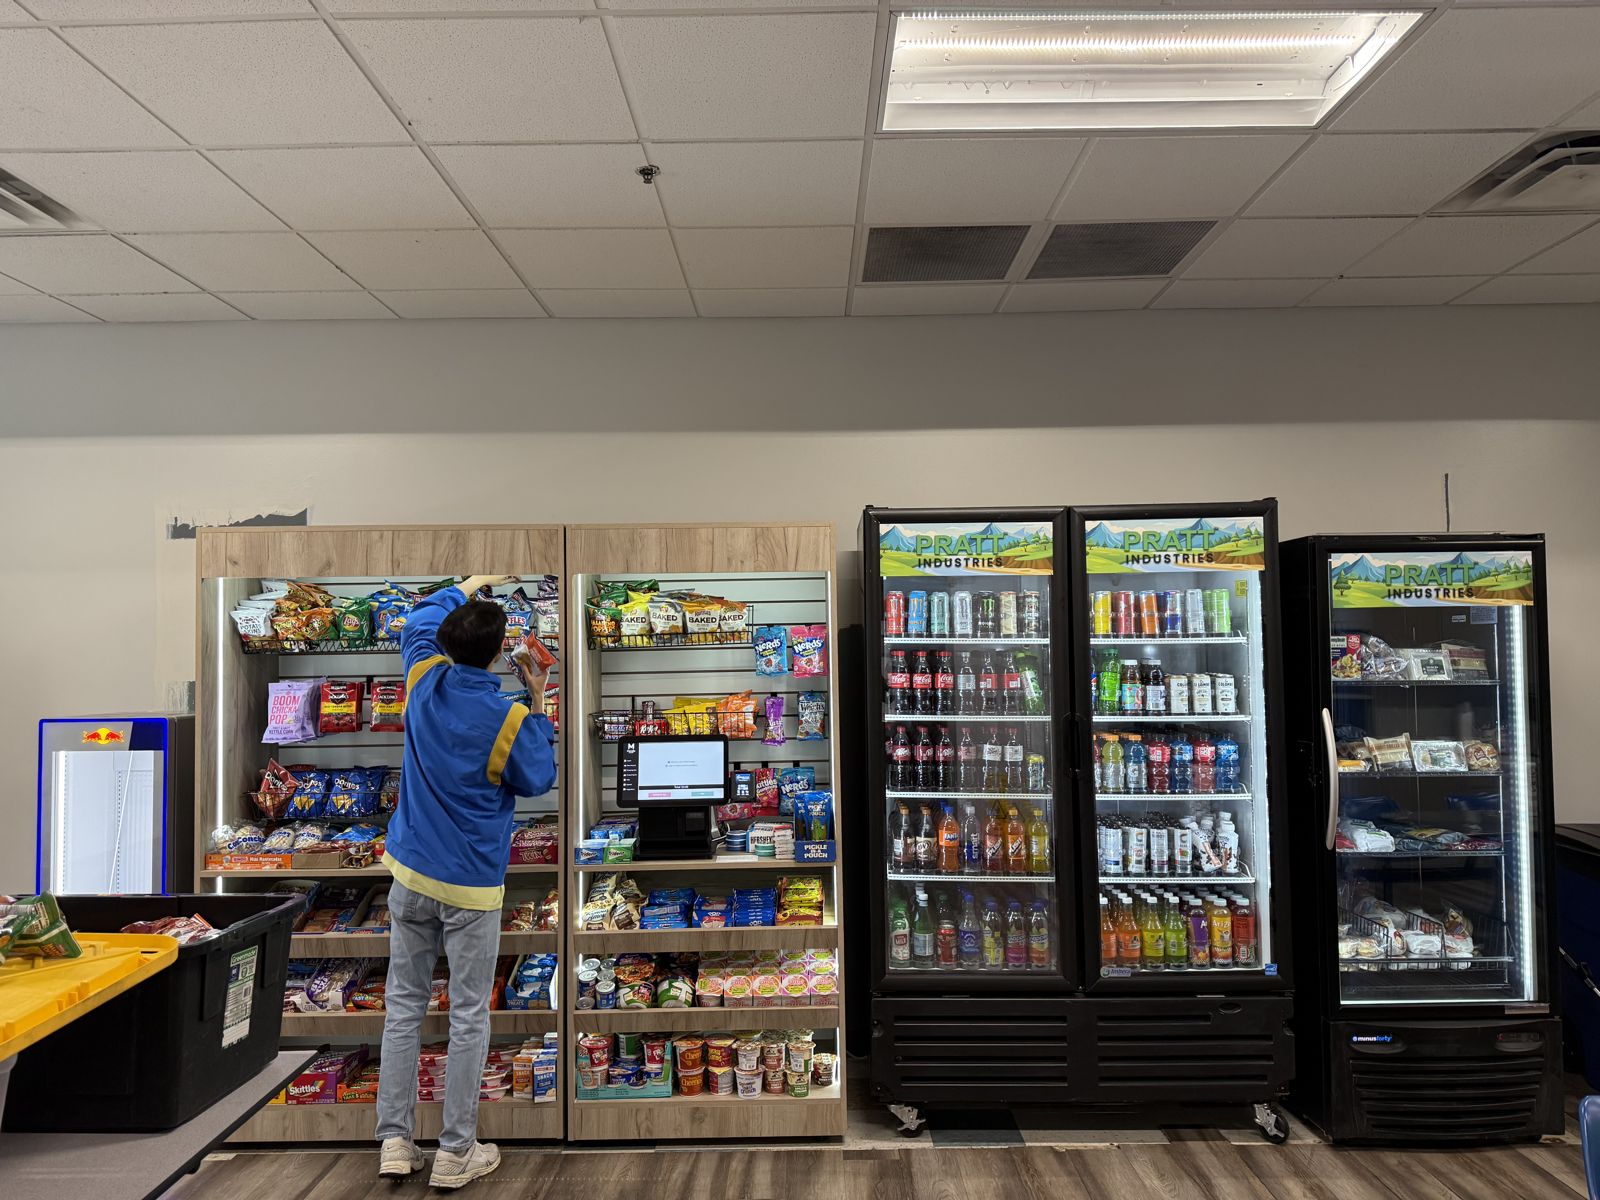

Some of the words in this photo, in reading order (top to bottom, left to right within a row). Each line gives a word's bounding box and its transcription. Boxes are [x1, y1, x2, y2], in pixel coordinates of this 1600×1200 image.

[915, 534, 1004, 556] PRATT
[1123, 529, 1216, 553] PRATT
[917, 557, 1003, 568] INDUSTRIES
[1125, 553, 1214, 565] INDUSTRIES
[1384, 563, 1475, 586] PRATT
[1387, 587, 1475, 599] INDUSTRIES
[652, 612, 678, 622] BAKED
[688, 616, 717, 624] BAKED
[273, 695, 300, 706] BOOM
[269, 714, 288, 725] POP
[334, 778, 360, 791] Doritos
[288, 1085, 321, 1096] Skittles
